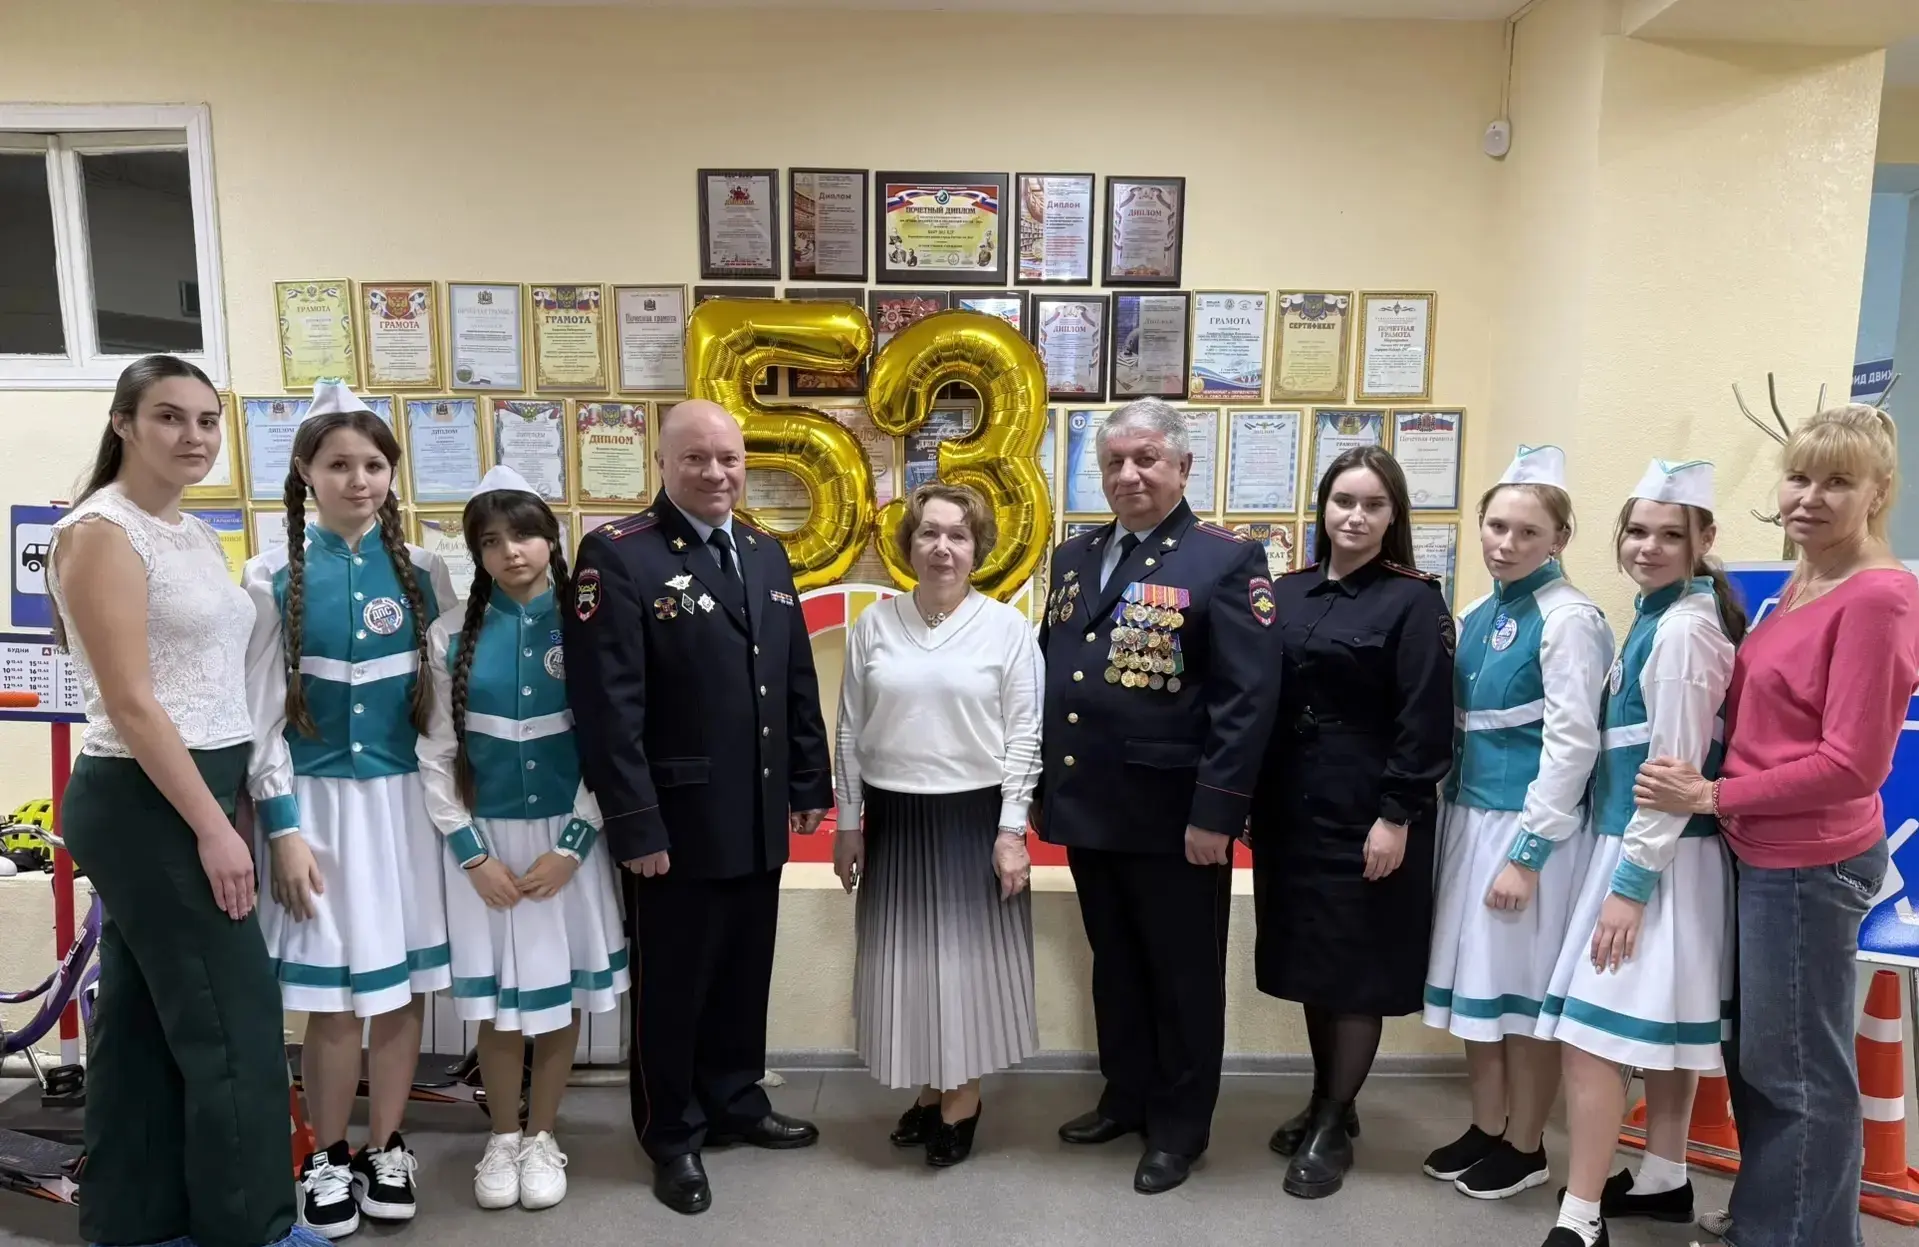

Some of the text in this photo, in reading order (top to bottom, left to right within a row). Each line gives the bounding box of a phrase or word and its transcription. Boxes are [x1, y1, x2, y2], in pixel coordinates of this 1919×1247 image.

[819, 192, 852, 200] Диплом
[1047, 201, 1081, 209] Диплом
[906, 206, 976, 215] ПОЧЕТНЫЙ ДИПЛОМ
[1128, 209, 1162, 217] ДИПЛОМ
[545, 316, 592, 324] ГРАМОТА
[1210, 317, 1251, 325] ГРАМОТА
[379, 321, 420, 329] ГРАМОТА
[1053, 325, 1087, 333] ДИПЛОМ
[1289, 322, 1336, 330] СЕРТИФИКАТ
[1854, 373, 1867, 385] ИД
[589, 434, 633, 445] ДИПЛОМ
